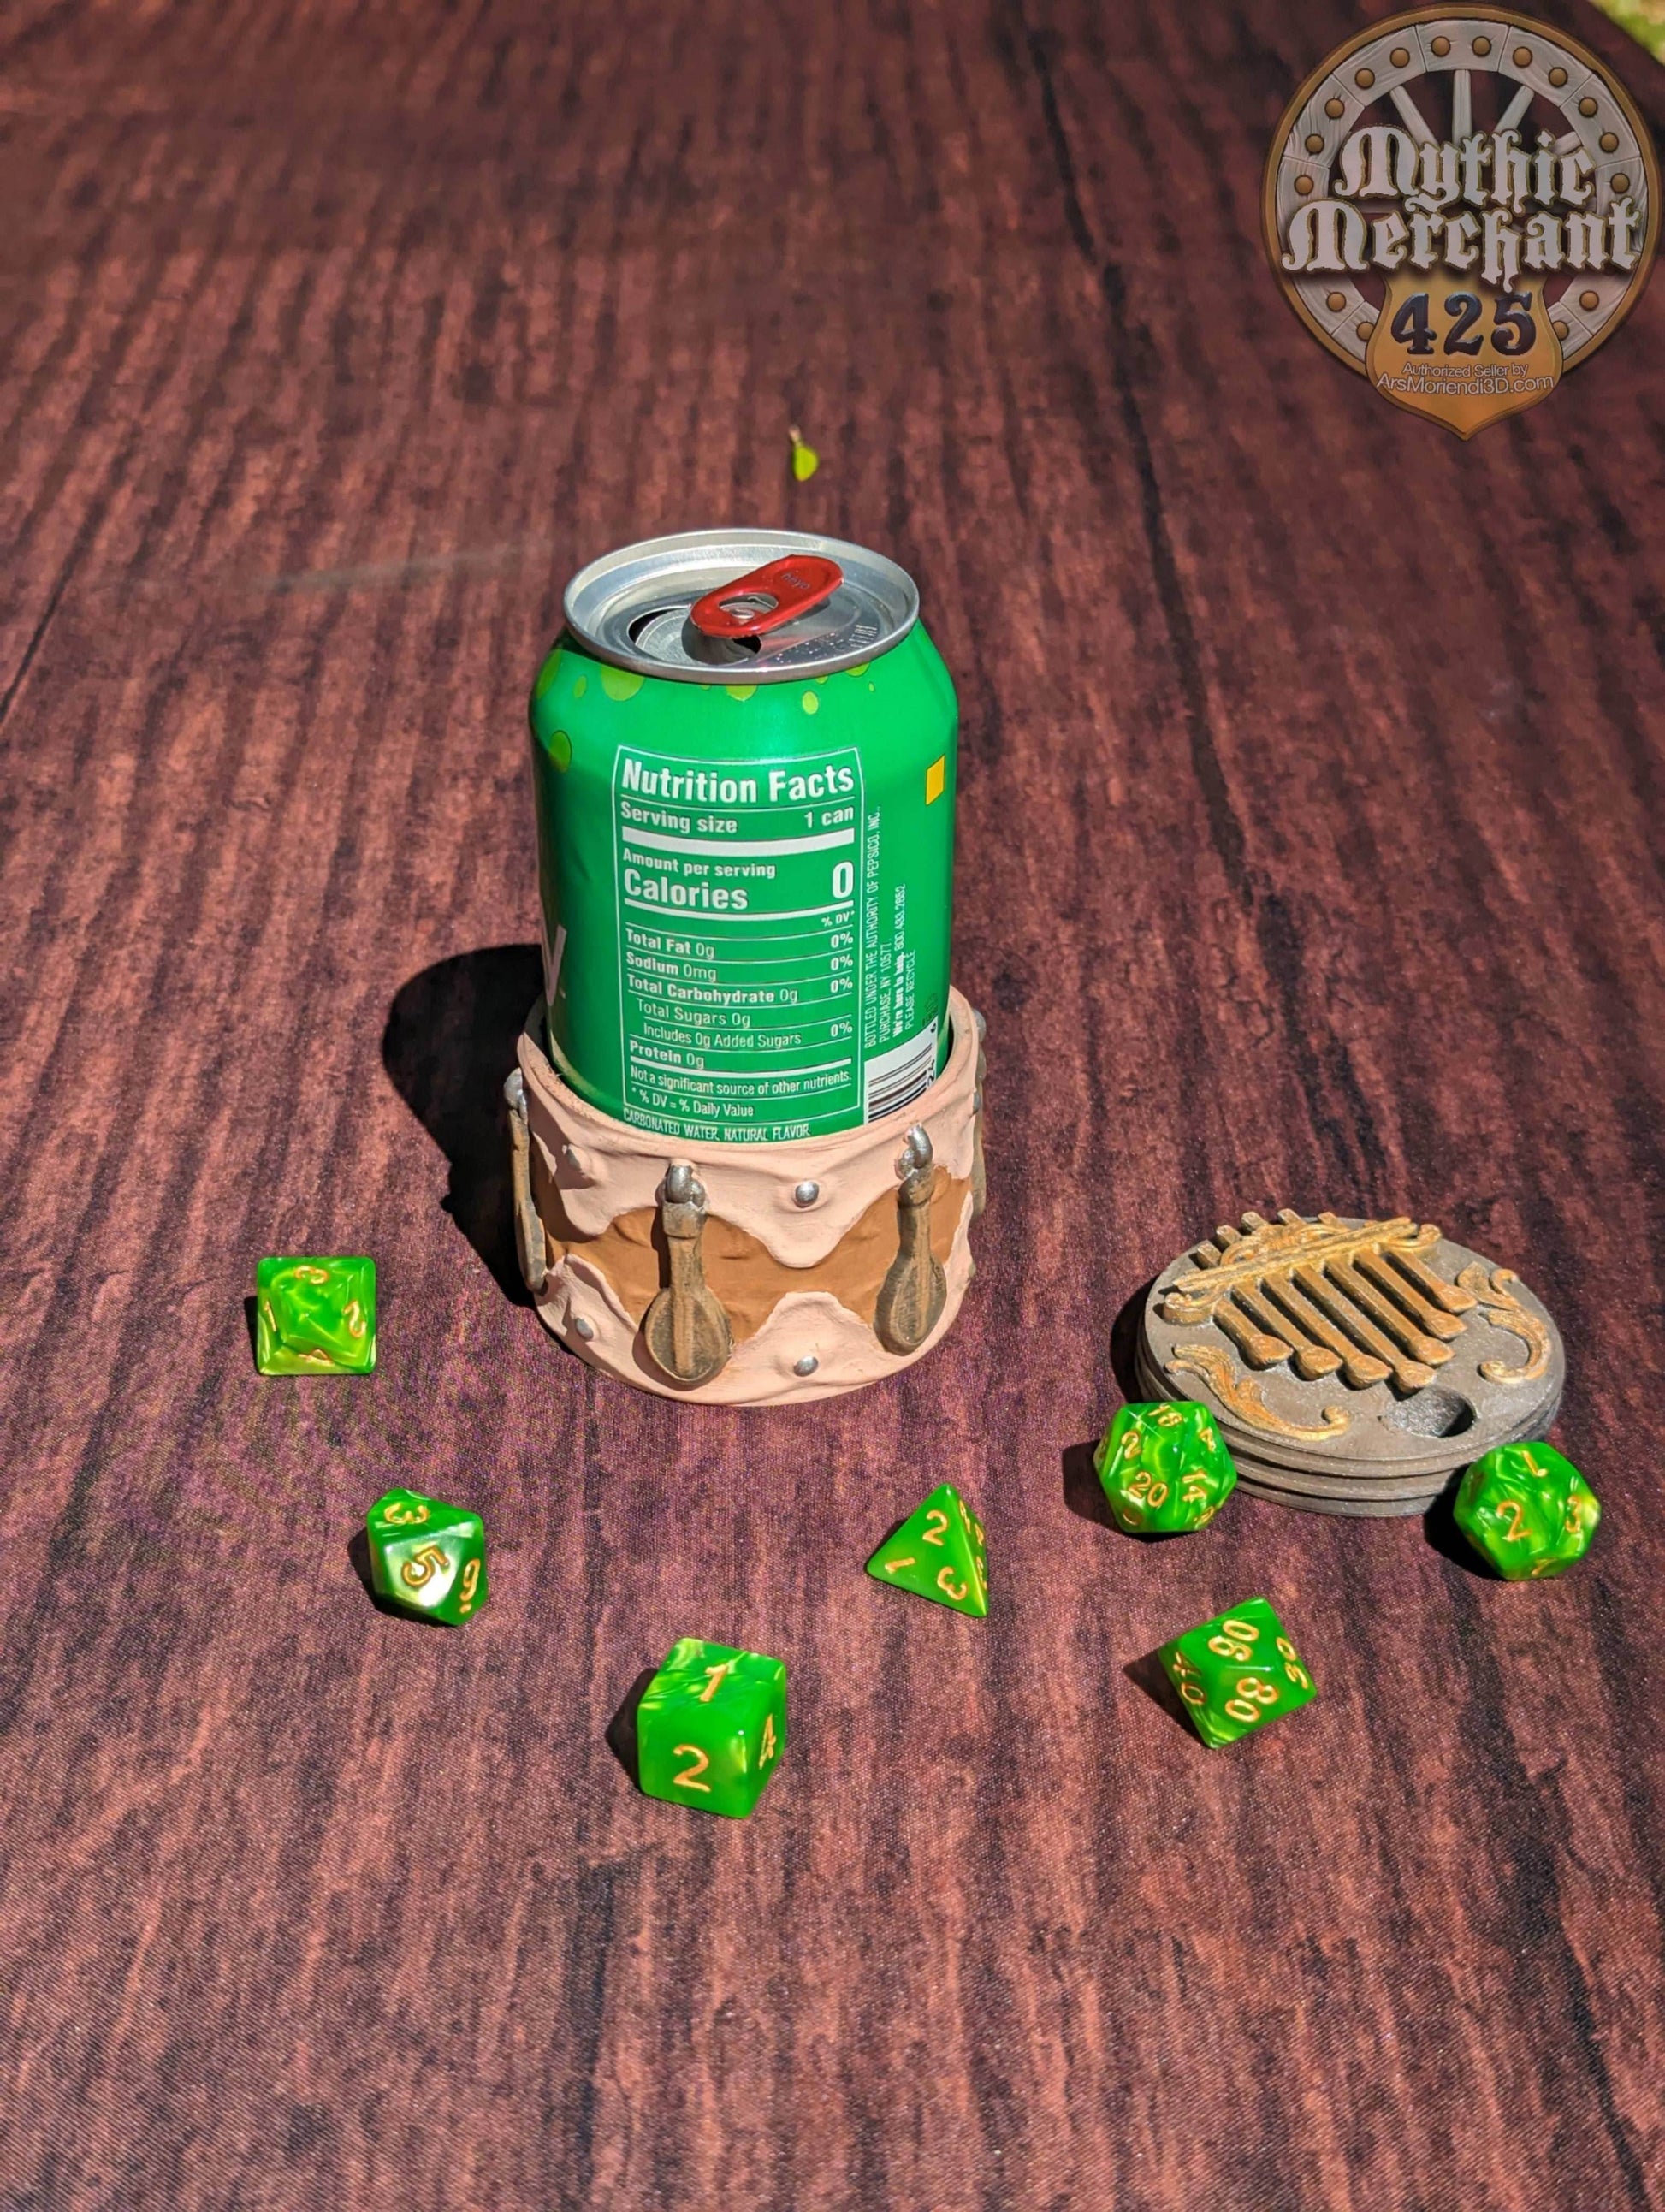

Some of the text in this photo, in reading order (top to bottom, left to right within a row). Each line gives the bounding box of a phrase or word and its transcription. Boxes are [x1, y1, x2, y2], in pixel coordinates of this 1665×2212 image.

[621, 759, 854, 803] Nutrition Facts
[620, 801, 738, 833] Serving size
[805, 806, 854, 828] 1 can
[623, 848, 776, 880] Amount per serving
[624, 861, 854, 910] Calories 0
[866, 880, 879, 894] OF
[866, 896, 880, 949] AUTHORITY
[625, 928, 715, 960] Total Fat 0g
[830, 931, 854, 948] 0%
[626, 952, 717, 983] Sodium 0mg
[830, 954, 854, 971] 0%
[865, 949, 878, 971] THE
[627, 974, 798, 1005] Total Carbohydrate 0g
[830, 976, 854, 993] 0%
[865, 970, 878, 1005] UNDER
[880, 976, 892, 989] NY
[905, 949, 916, 1030] PLEASE RECYCLE
[636, 998, 750, 1029] Total Sugars 0g
[830, 1021, 853, 1038] 0%
[864, 1005, 877, 1049] BOTTLED
[643, 1022, 802, 1049] Includes 0g Added Sugars
[630, 1039, 705, 1070] Protein 0g
[631, 1064, 852, 1095] Not a significant source of other nutrients.
[652, 1093, 667, 1108] DV
[678, 1099, 690, 1112] %
[693, 1100, 720, 1118] Daily
[722, 1102, 754, 1117] Value
[623, 1107, 681, 1136] CARBONATED
[724, 1126, 768, 1141] NATURAL
[1128, 1471, 1168, 1508] 20
[384, 1502, 430, 1524] 3
[921, 1509, 948, 1545] 2
[1496, 1499, 1532, 1542] 2
[1565, 1494, 1581, 1533] 3
[400, 1544, 451, 1588] 5
[885, 1557, 915, 1574] 1
[937, 1565, 968, 1600] 3
[699, 1663, 728, 1702] 1
[1225, 1677, 1278, 1722] 80
[759, 1712, 777, 1770] 4
[673, 1743, 711, 1793] 2
